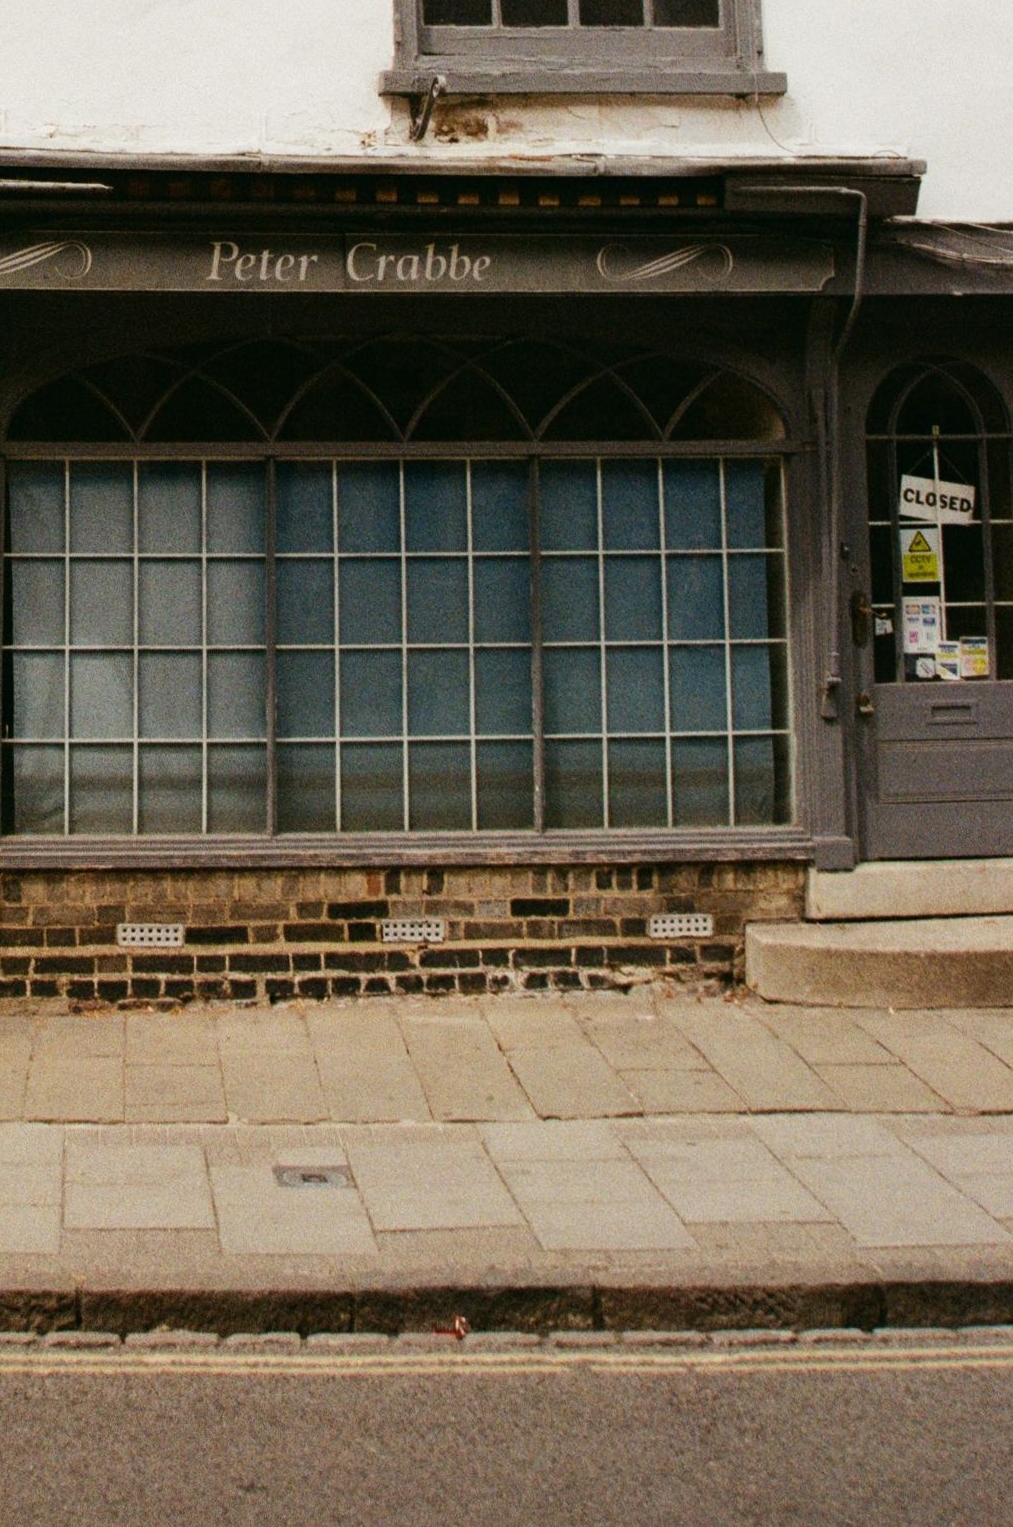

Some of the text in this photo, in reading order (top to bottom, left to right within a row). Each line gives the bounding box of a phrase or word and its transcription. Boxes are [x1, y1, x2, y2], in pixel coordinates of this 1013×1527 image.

[205, 241, 491, 281] Peter Crabbe
[903, 489, 972, 513] CLOSED
